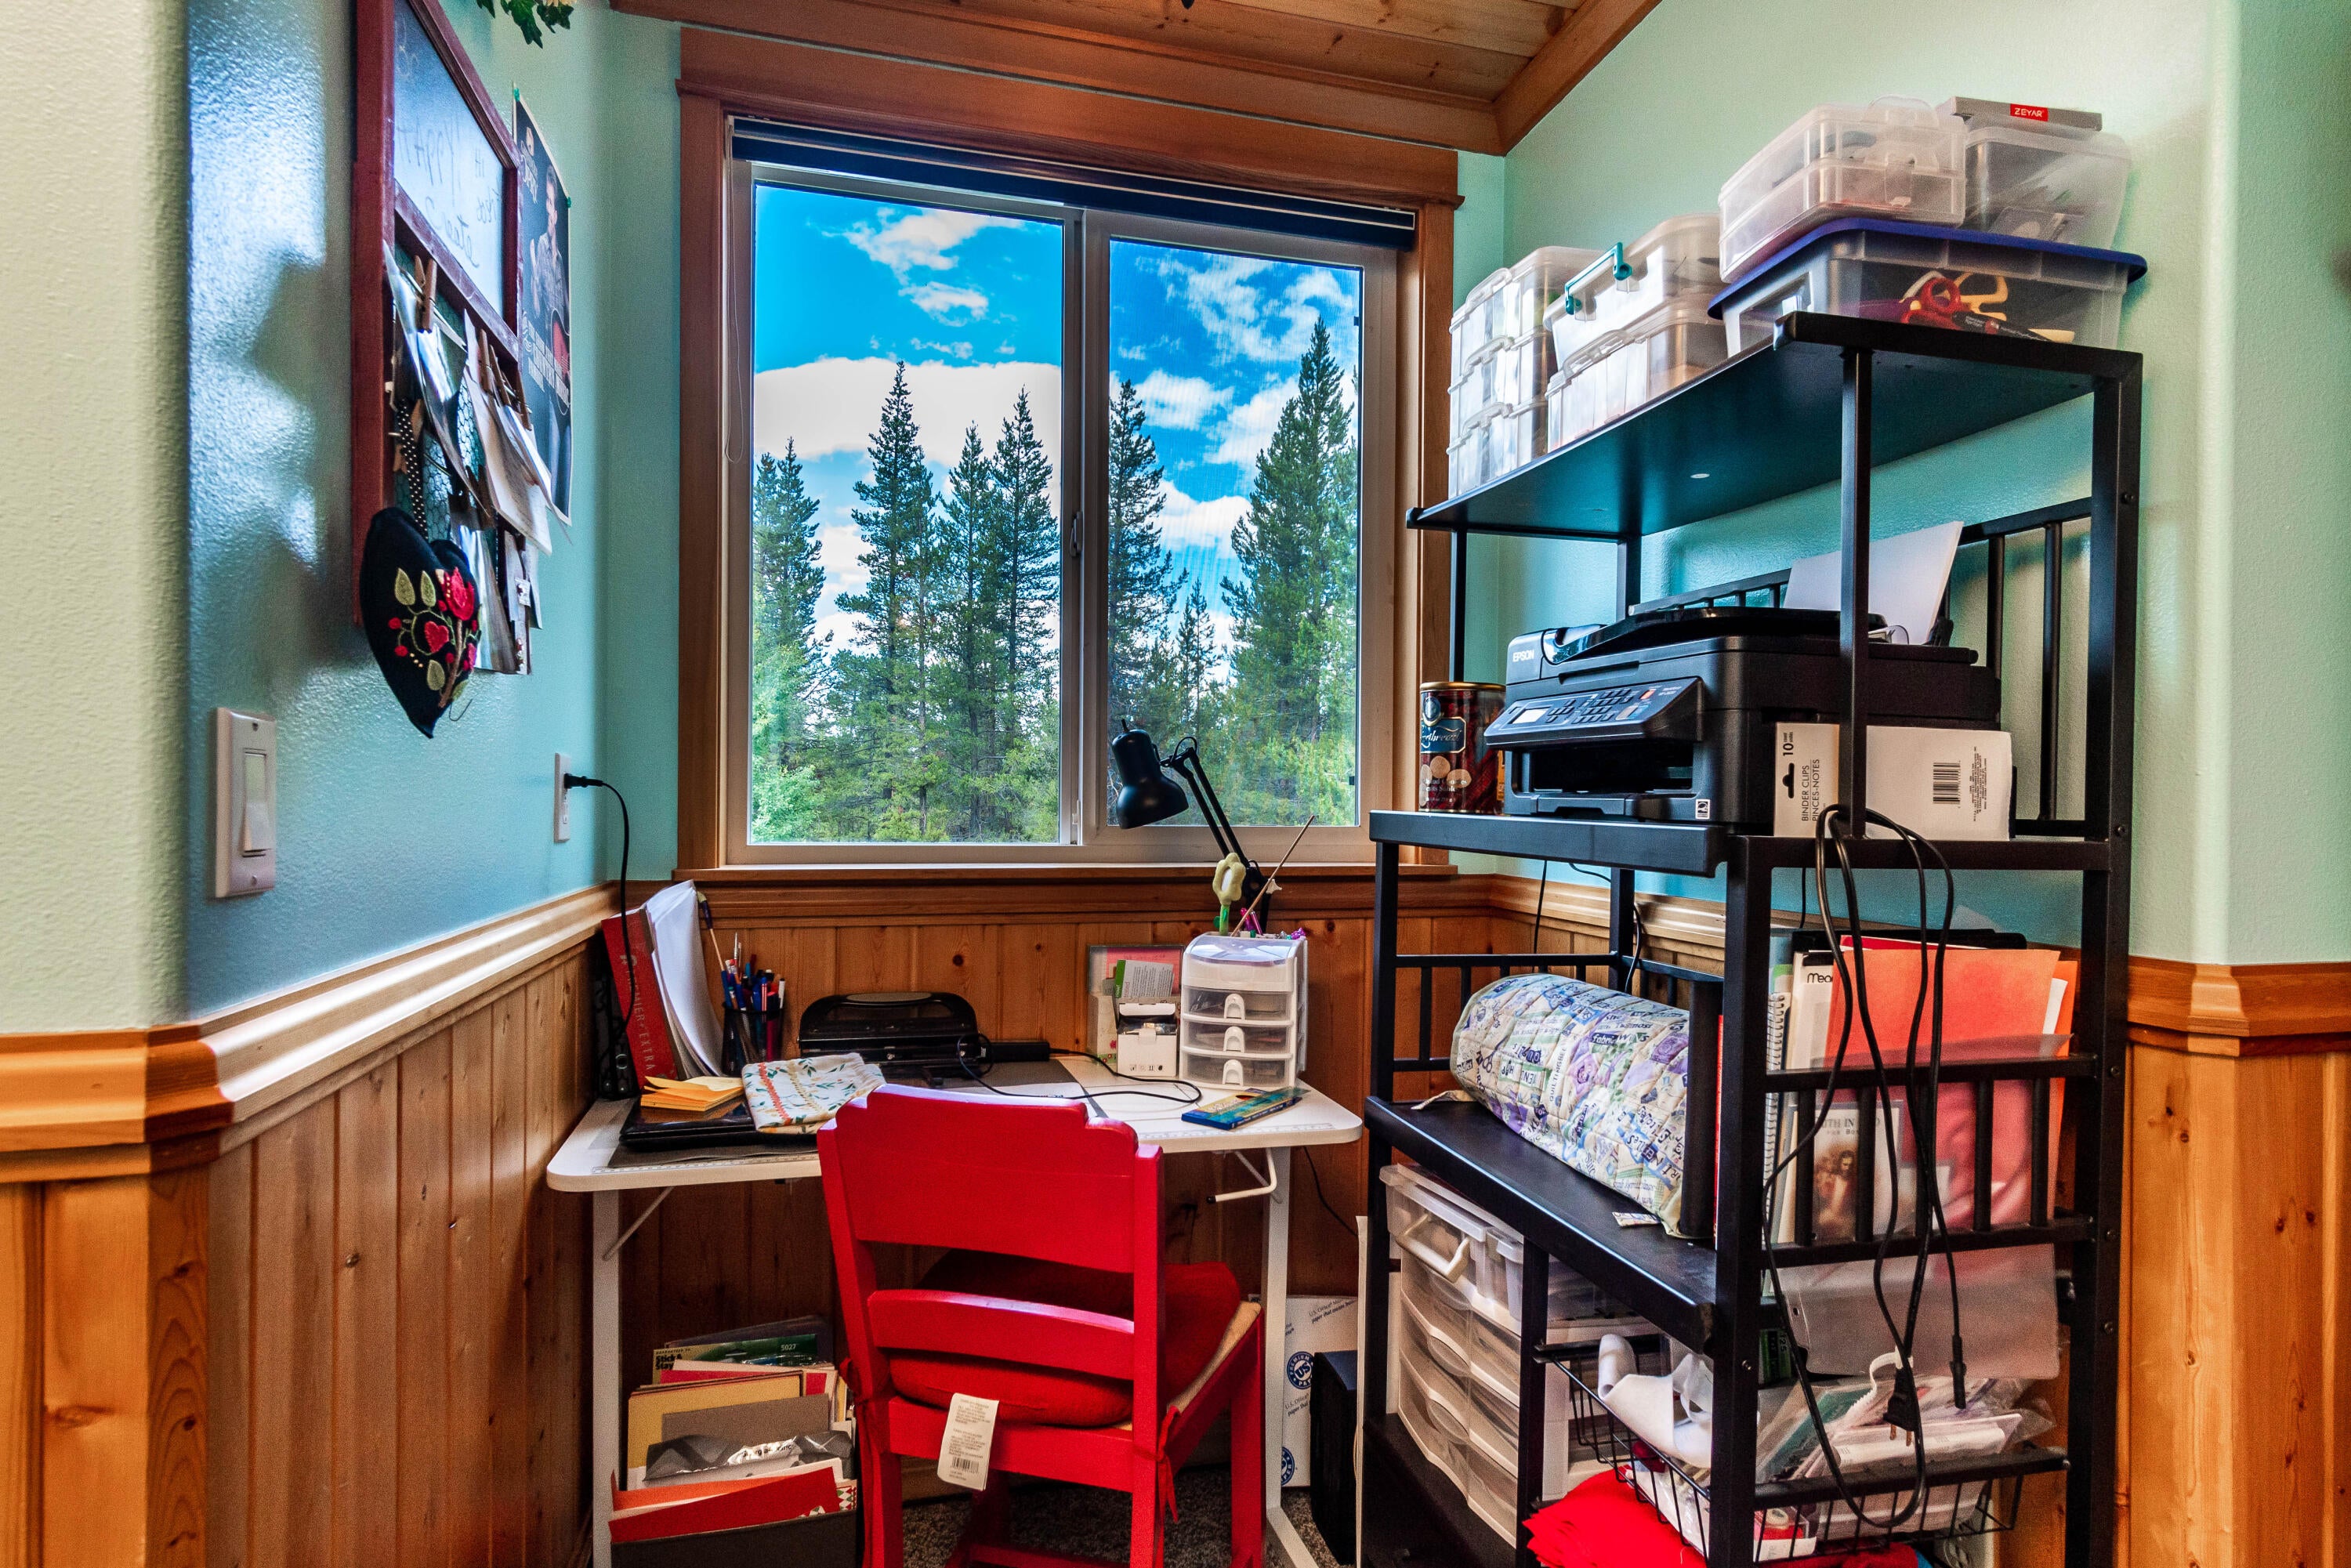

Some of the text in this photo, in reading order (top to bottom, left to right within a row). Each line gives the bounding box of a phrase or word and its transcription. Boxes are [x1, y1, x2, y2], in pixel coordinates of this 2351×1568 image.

[2014, 107, 2042, 118] ZEYAR
[1512, 650, 1534, 662] EPSON
[1783, 743, 1794, 756] 10
[1807, 973, 1833, 983] Mea
[1592, 1034, 1616, 1045] fabric
[639, 1032, 655, 1070] EXTRA
[1844, 1118, 1855, 1128] IN
[1311, 1314, 1323, 1324] paper
[656, 1362, 674, 1371] Stay
[1289, 1354, 1310, 1376] PREMIUM
[1295, 1362, 1310, 1378] US
[1288, 1407, 1299, 1417] paper
